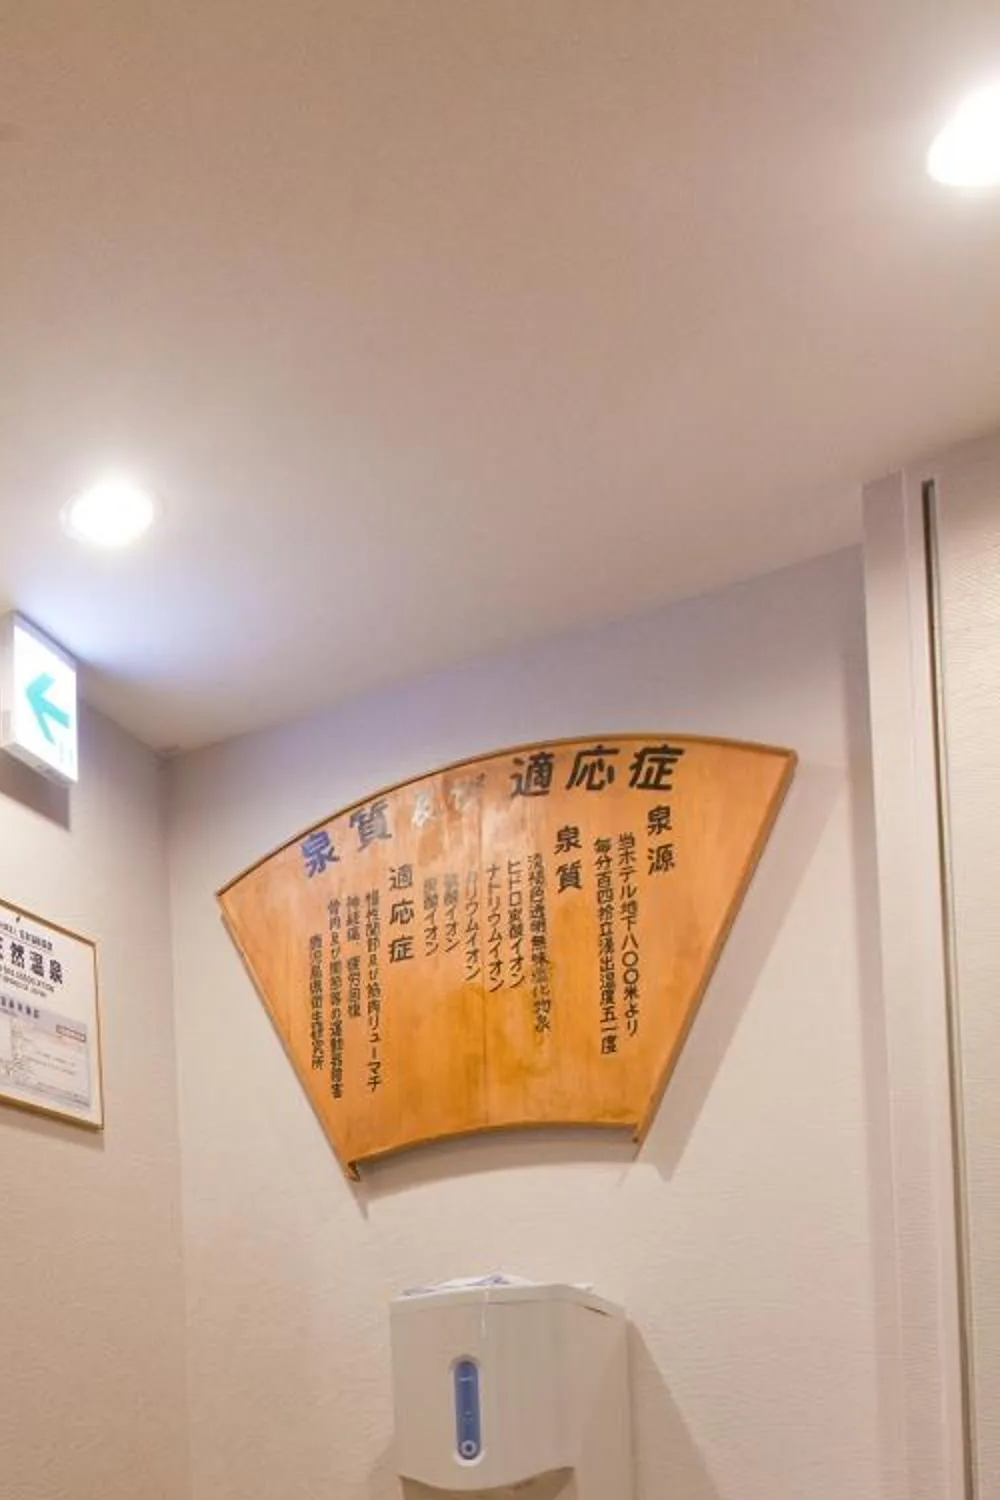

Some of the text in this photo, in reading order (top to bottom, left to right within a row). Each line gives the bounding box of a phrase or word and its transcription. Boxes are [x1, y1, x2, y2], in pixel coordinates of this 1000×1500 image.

[553, 825, 582, 893] 泉質
[647, 804, 675, 875] 泉源
[388, 864, 414, 964] 適応症
[486, 864, 504, 993] ナトリウムイオン
